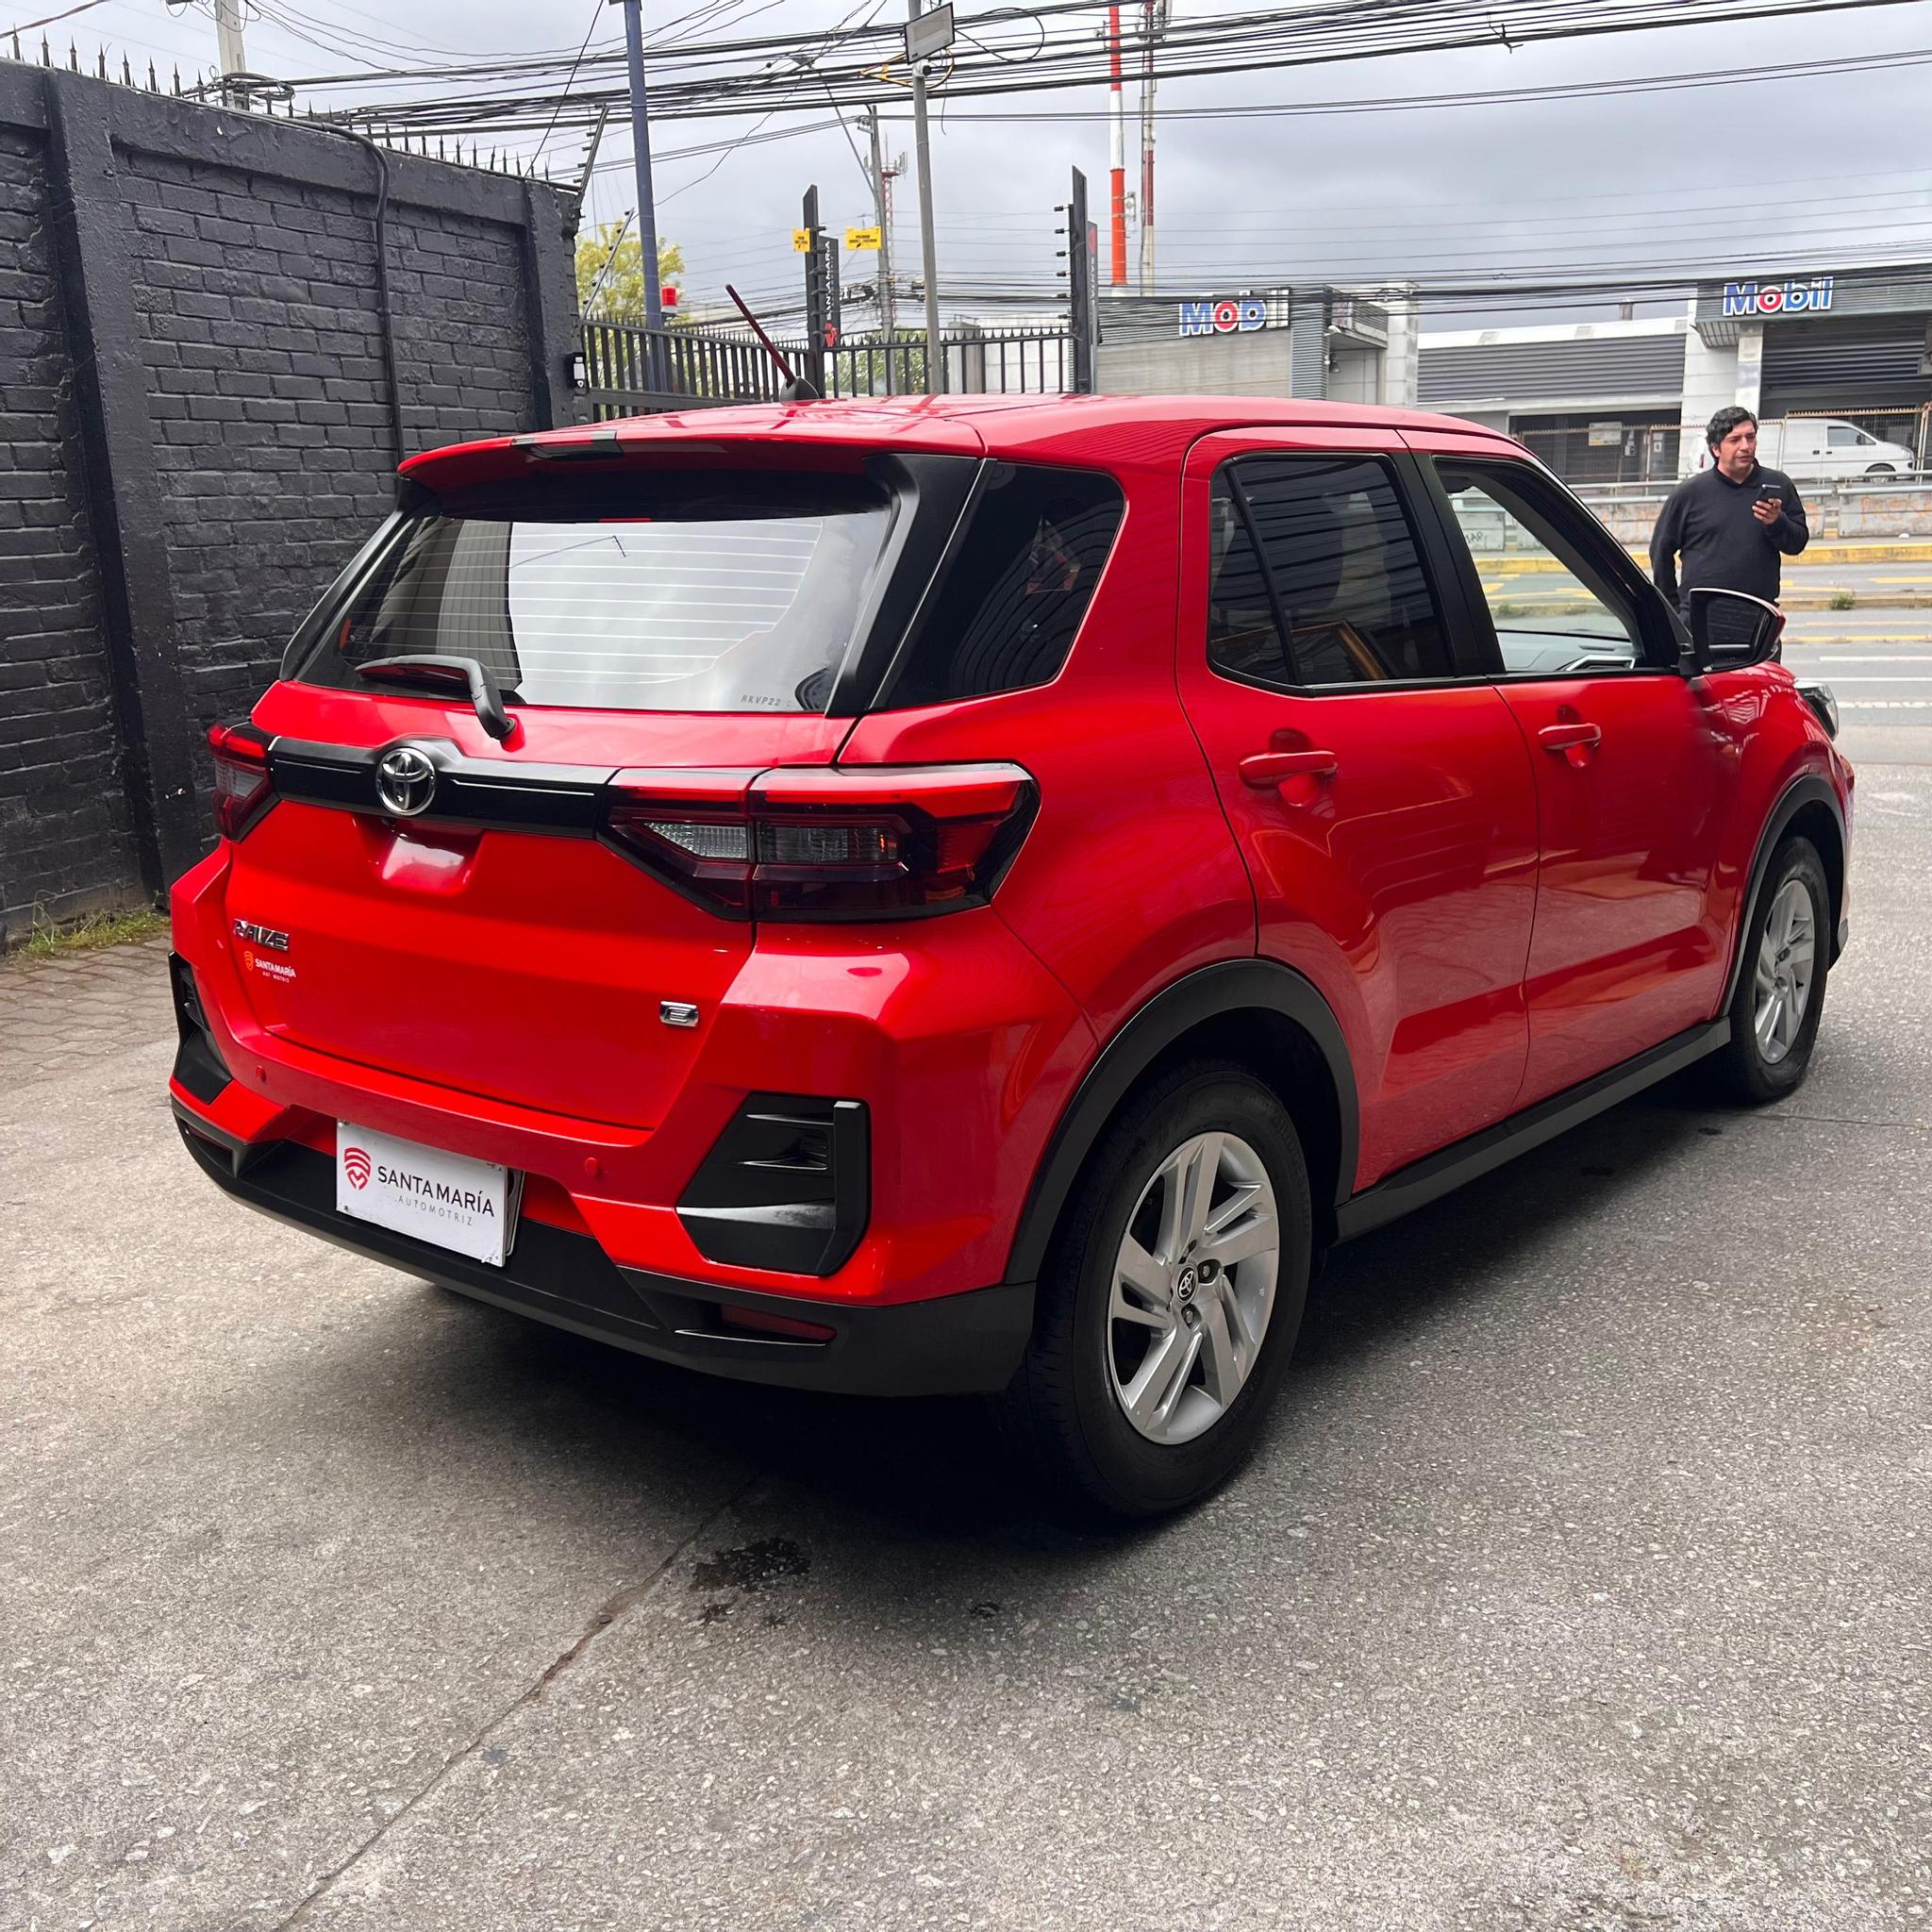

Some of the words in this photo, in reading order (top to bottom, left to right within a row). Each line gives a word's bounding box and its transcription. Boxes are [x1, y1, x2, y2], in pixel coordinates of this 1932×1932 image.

[1723, 276, 1834, 317] Mobil
[377, 1165, 495, 1218] SANTAMARÍA
[397, 1194, 473, 1226] AUTOMOTRIZ
